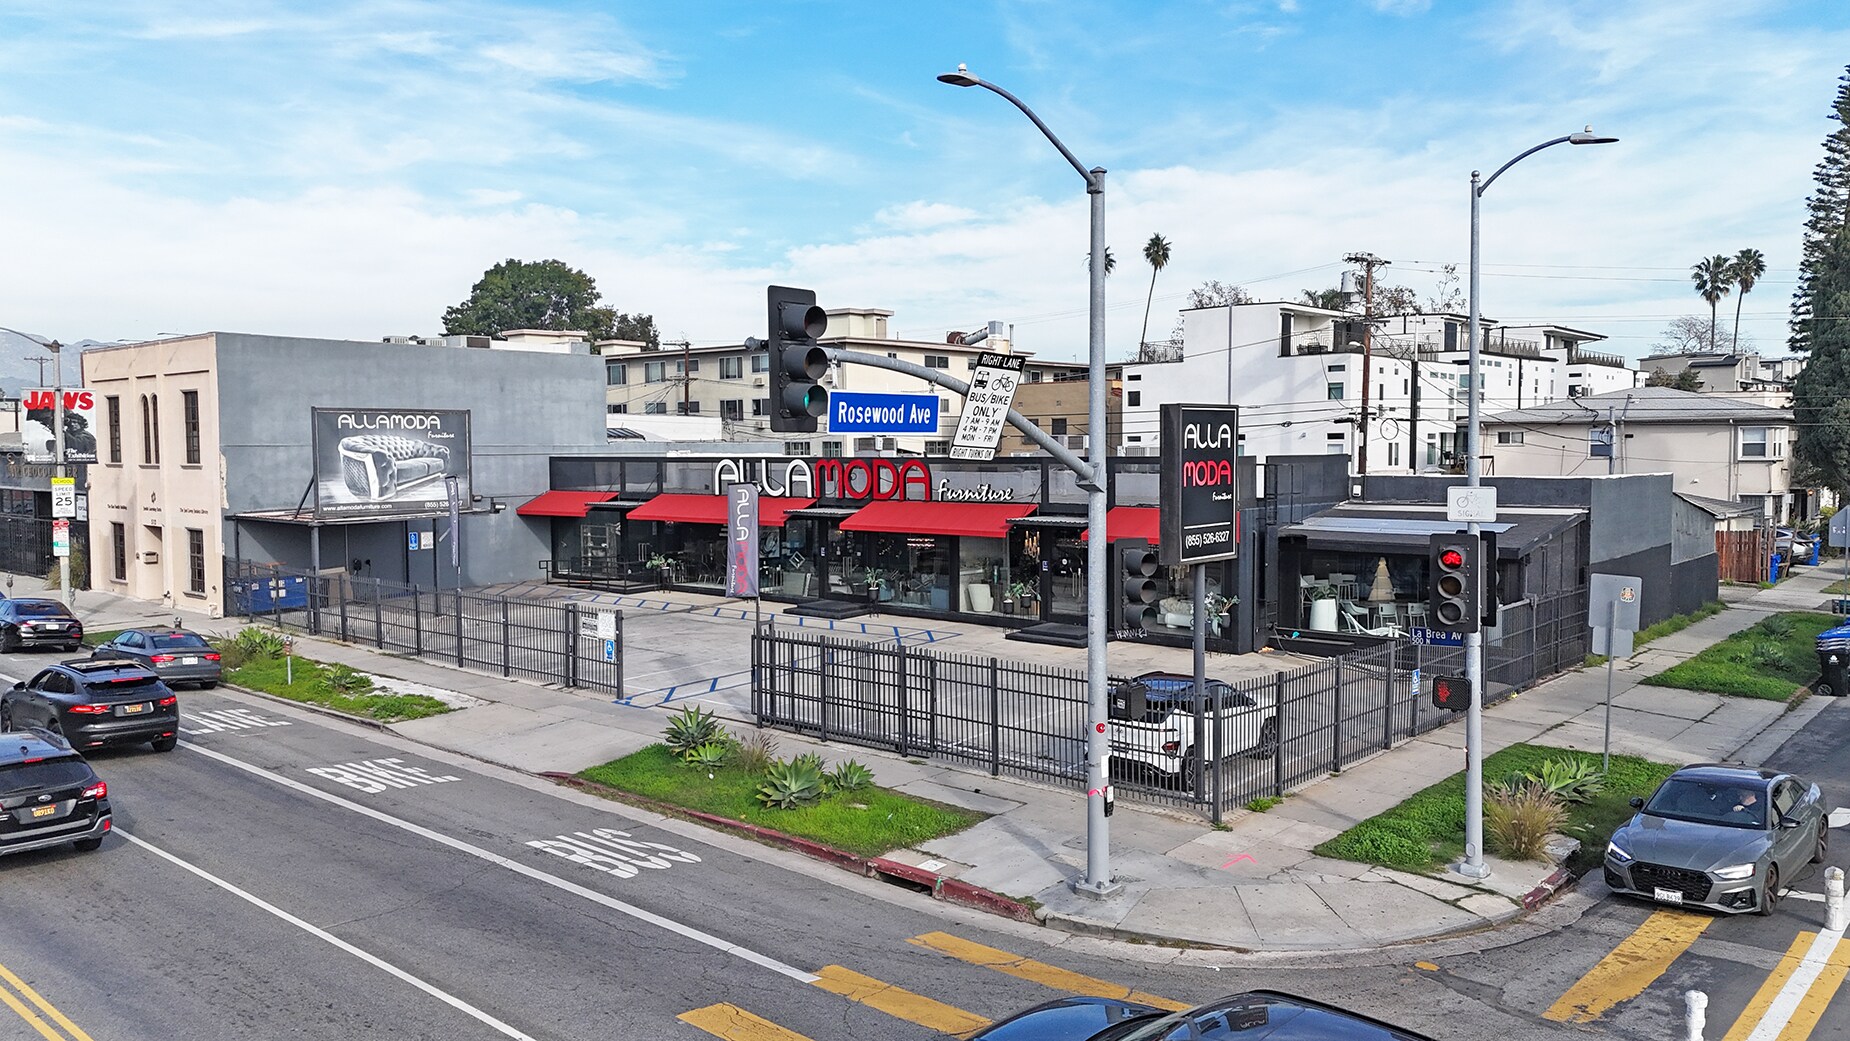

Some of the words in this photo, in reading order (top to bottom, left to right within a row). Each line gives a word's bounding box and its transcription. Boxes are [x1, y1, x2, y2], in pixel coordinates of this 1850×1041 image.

[981, 354, 1002, 366] RIGHT
[1003, 357, 1021, 369] LANE
[23, 391, 94, 410] JAWS
[969, 392, 1010, 405] BUS/BIKE
[838, 401, 905, 424] Rosewood
[909, 403, 931, 424] Ave
[973, 406, 998, 417] ONLY
[337, 414, 441, 430] ALLAMODA
[961, 433, 975, 441] MON
[1184, 424, 1231, 449] ALLA
[952, 448, 967, 457] RIGHT
[968, 448, 984, 458] TURNS
[984, 450, 992, 459] OK
[1183, 459, 1231, 487] MODA
[55, 497, 73, 506] 25
[1185, 533, 1202, 549] (855)
[1203, 531, 1230, 545] 526-6327
[1412, 628, 1422, 638] La
[1426, 629, 1446, 640] Brea
[1451, 631, 1463, 640] Av
[1412, 637, 1424, 645] 500
[178, 708, 292, 735] LANE
[305, 758, 462, 794] BIKE
[525, 828, 702, 879] BUS
